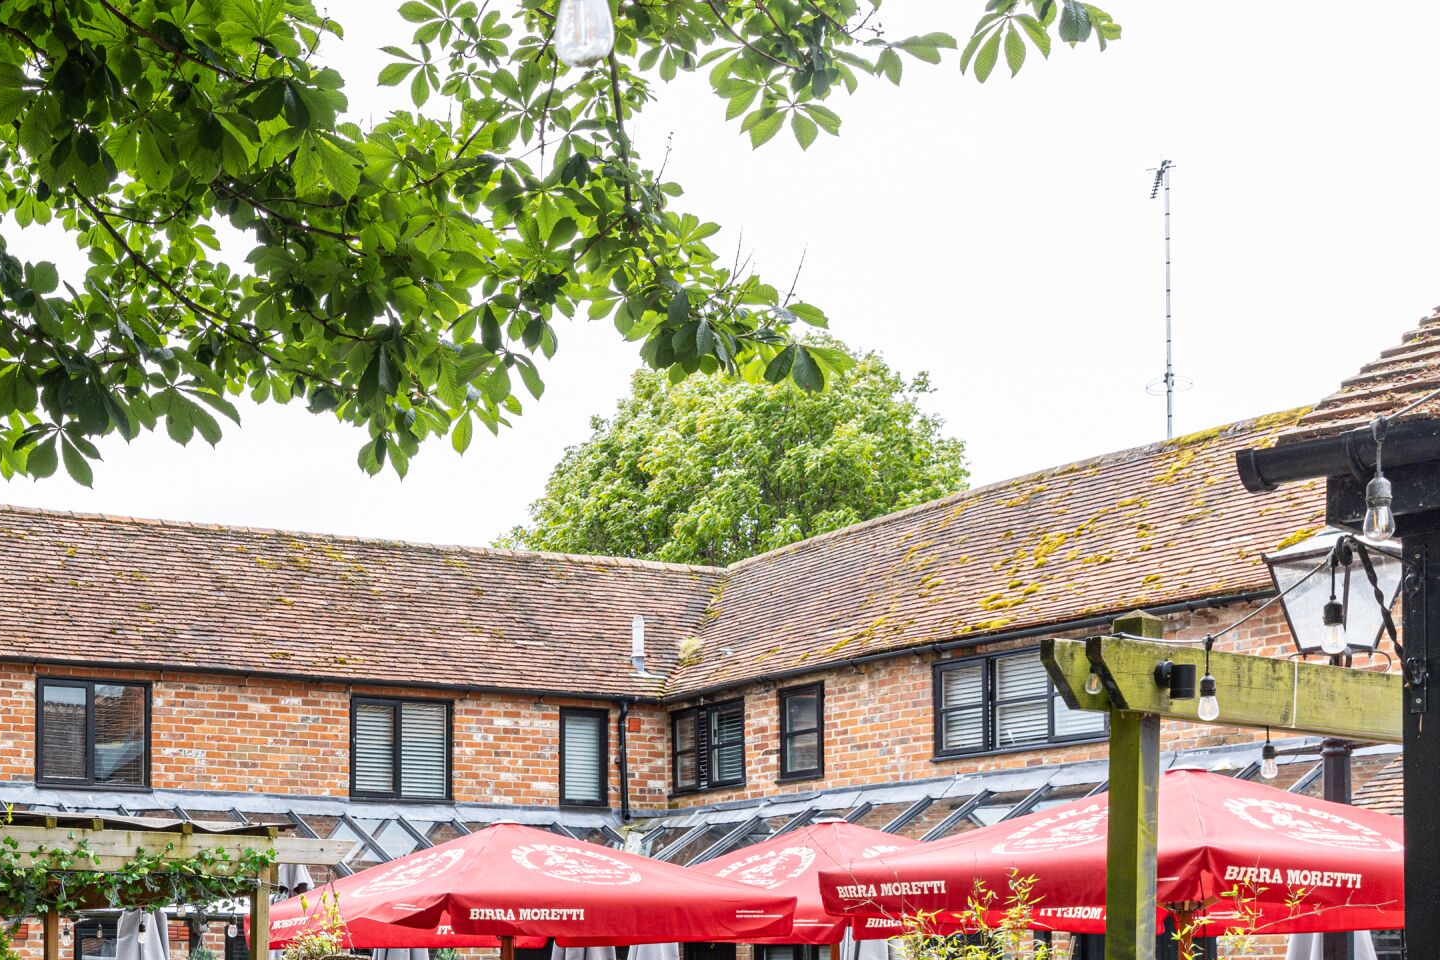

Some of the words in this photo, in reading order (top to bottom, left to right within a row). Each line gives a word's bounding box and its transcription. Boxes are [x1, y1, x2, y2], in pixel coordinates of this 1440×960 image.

[1224, 865, 1283, 885] BIRRA
[1286, 868, 1363, 889] MORETTI
[835, 884, 878, 899] BIRRA
[880, 880, 947, 897] MORETTI
[469, 908, 516, 921] BIRRA
[519, 908, 585, 921] MORETTI
